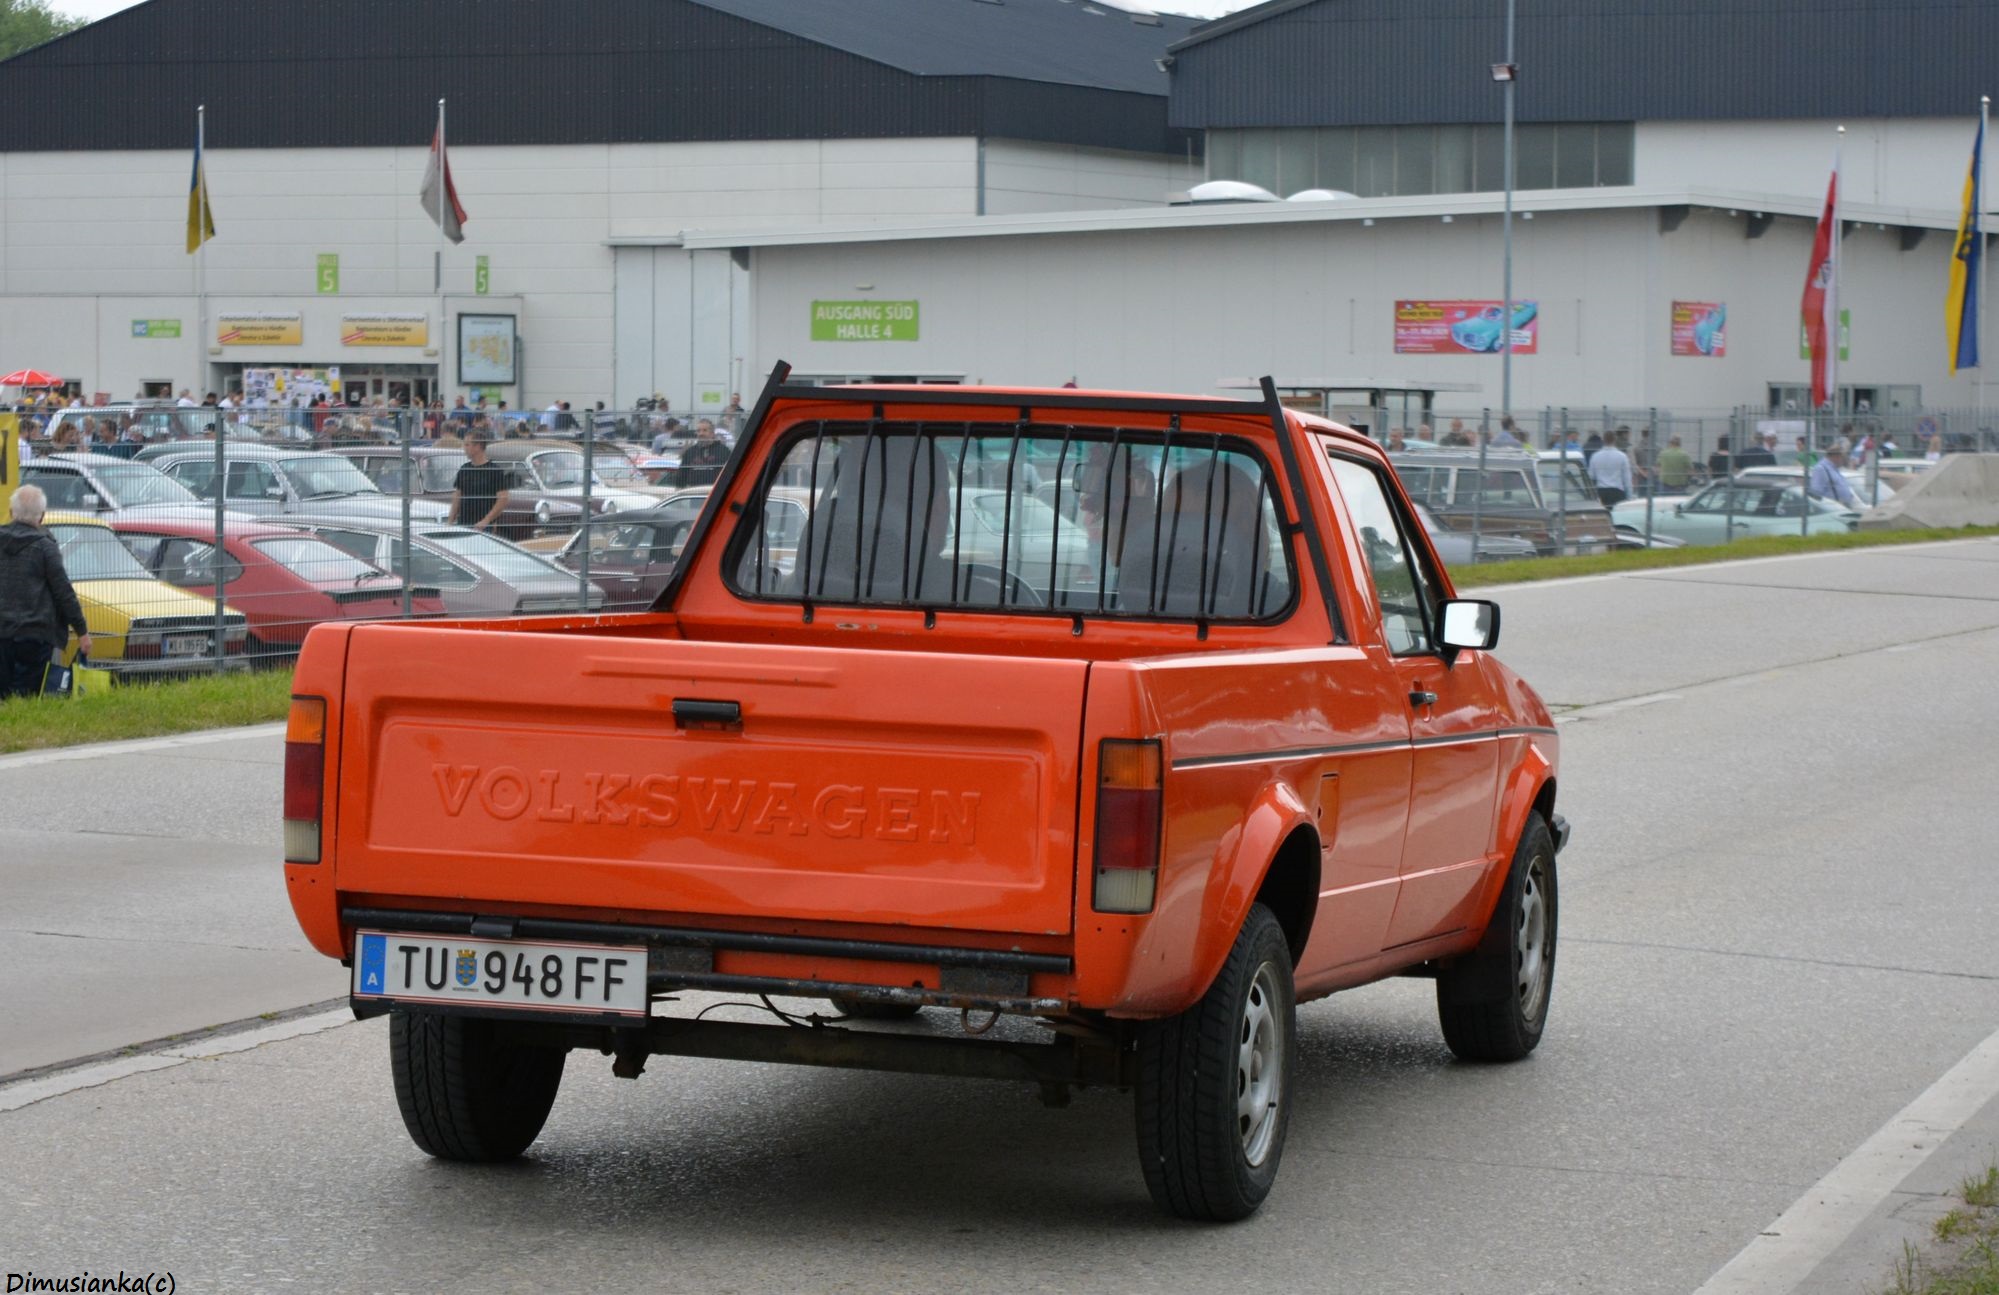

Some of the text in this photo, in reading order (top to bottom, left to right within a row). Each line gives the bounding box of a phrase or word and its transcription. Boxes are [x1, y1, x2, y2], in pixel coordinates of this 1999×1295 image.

[323, 269, 334, 291] 5
[477, 270, 487, 292] 5
[816, 303, 913, 320] AUSGANG SÜD
[837, 324, 893, 338] HALLE 4
[431, 762, 983, 845] VOLKSWAGEN
[398, 945, 448, 990] TU
[366, 972, 378, 986] A
